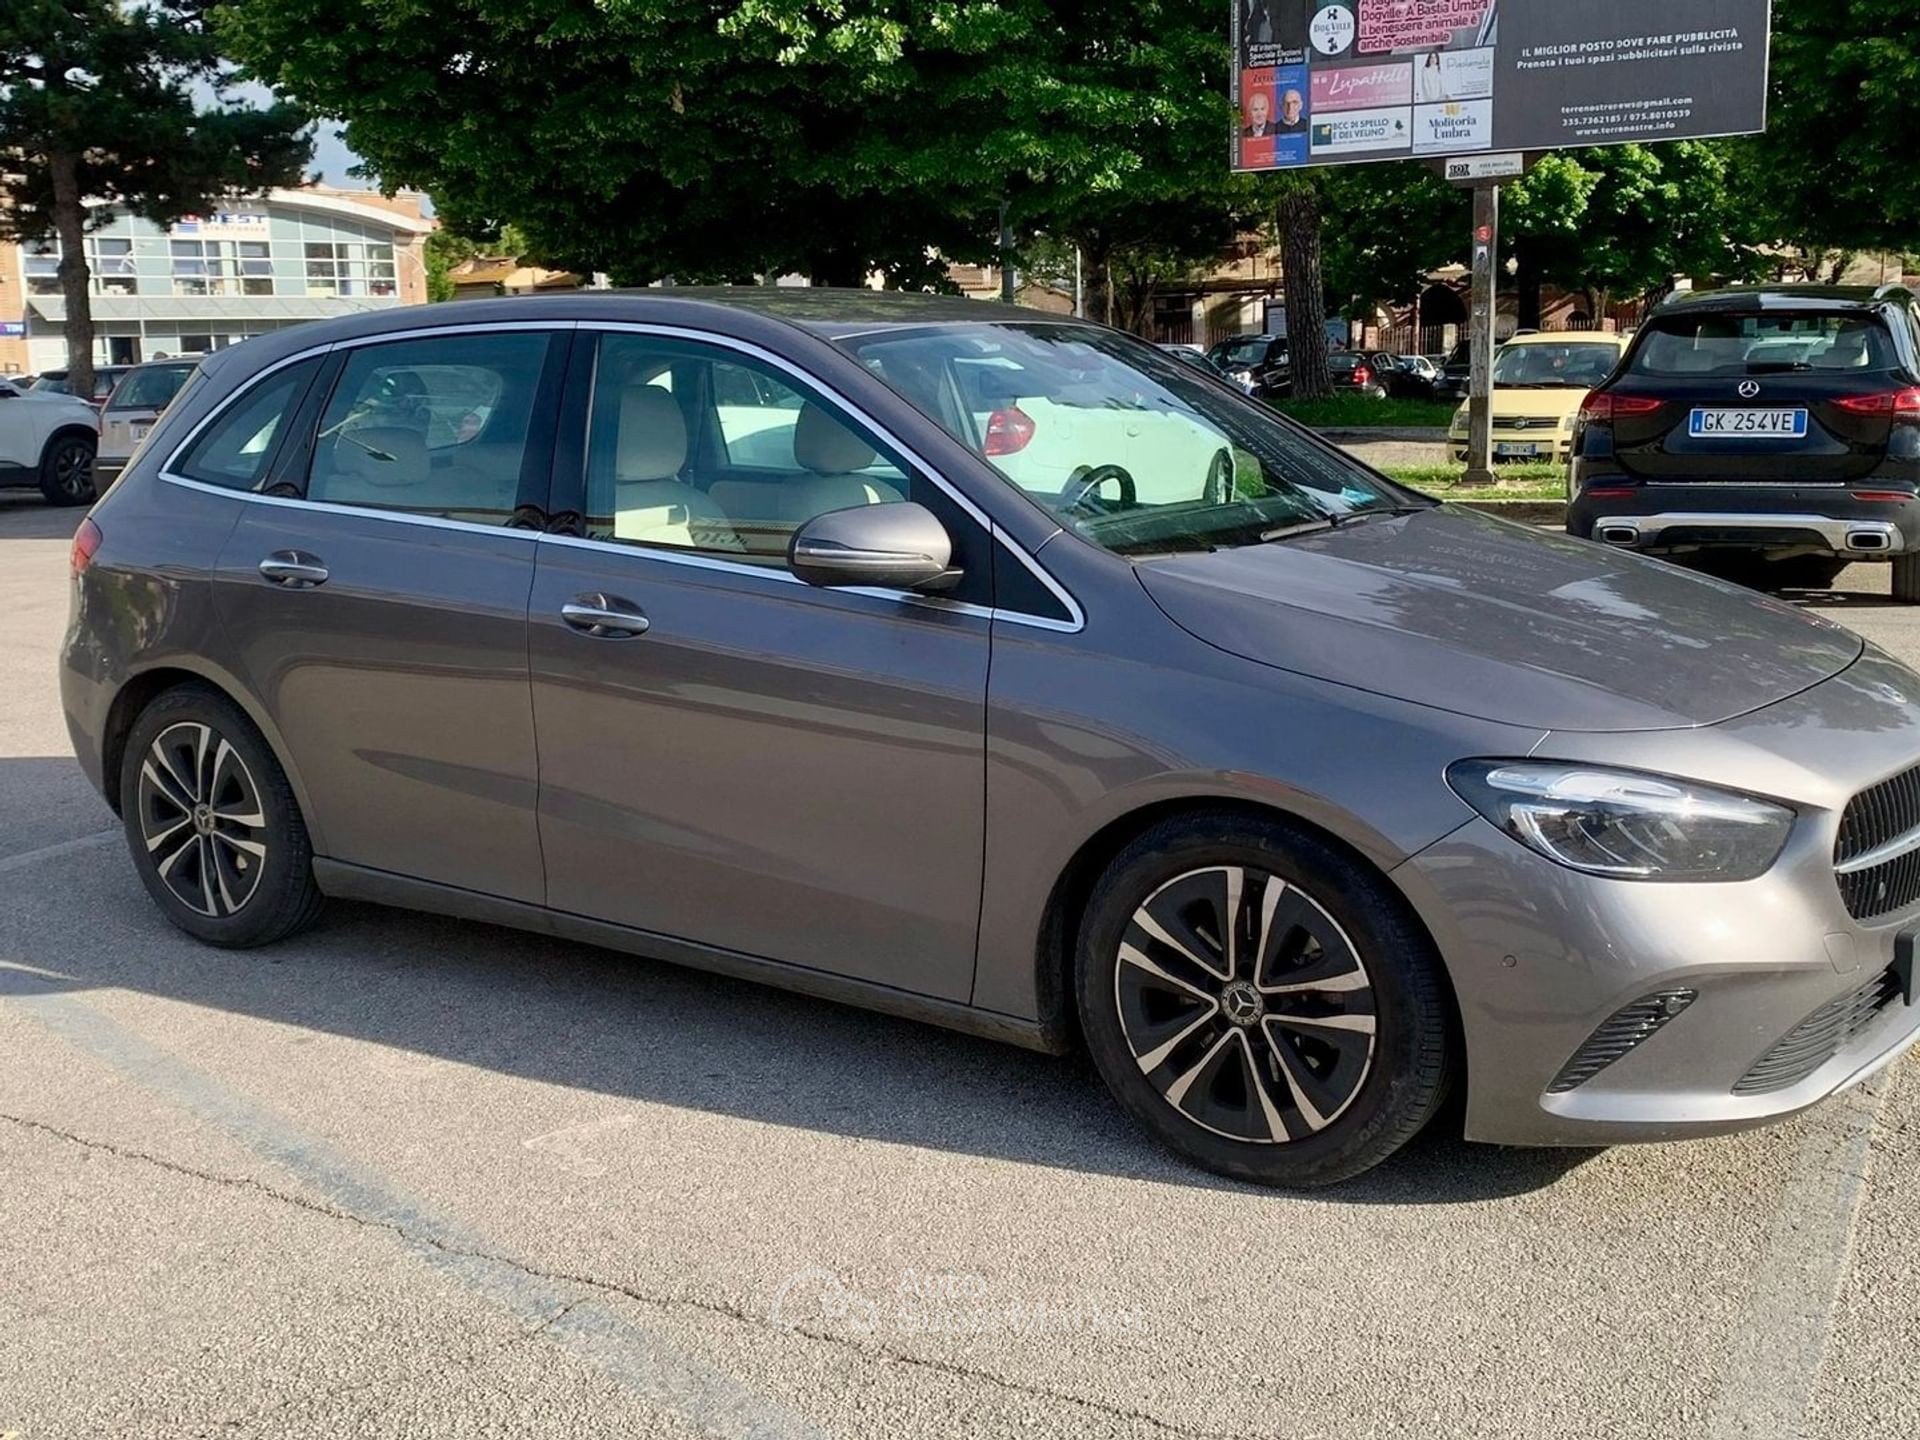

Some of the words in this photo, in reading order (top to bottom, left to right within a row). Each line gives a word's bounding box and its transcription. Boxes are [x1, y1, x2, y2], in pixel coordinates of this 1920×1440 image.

[1406, 5, 1414, 16] A
[1417, 2, 1449, 16] Bastia
[1369, 18, 1422, 34] benessere
[1425, 16, 1469, 29] animale
[1360, 38, 1392, 50] anche
[1522, 48, 1531, 57] IL
[1533, 44, 1578, 56] MIGLIOR
[1579, 40, 1614, 52] POSTO
[1616, 37, 1644, 48] DOVE
[1646, 34, 1673, 46] FARE
[1517, 60, 1556, 69] Prenota
[1564, 55, 1585, 65] tuoi
[1587, 53, 1615, 64] spazi
[1680, 43, 1706, 55] sulla
[1708, 41, 1743, 53] rivista
[1333, 122, 1349, 130] BCC
[1360, 118, 1389, 128] SPELLO
[1429, 115, 1477, 128] Molitoria
[1434, 126, 1471, 139] Umbra
[1704, 412, 1725, 430] GK
[1734, 412, 1792, 430] 254VE
